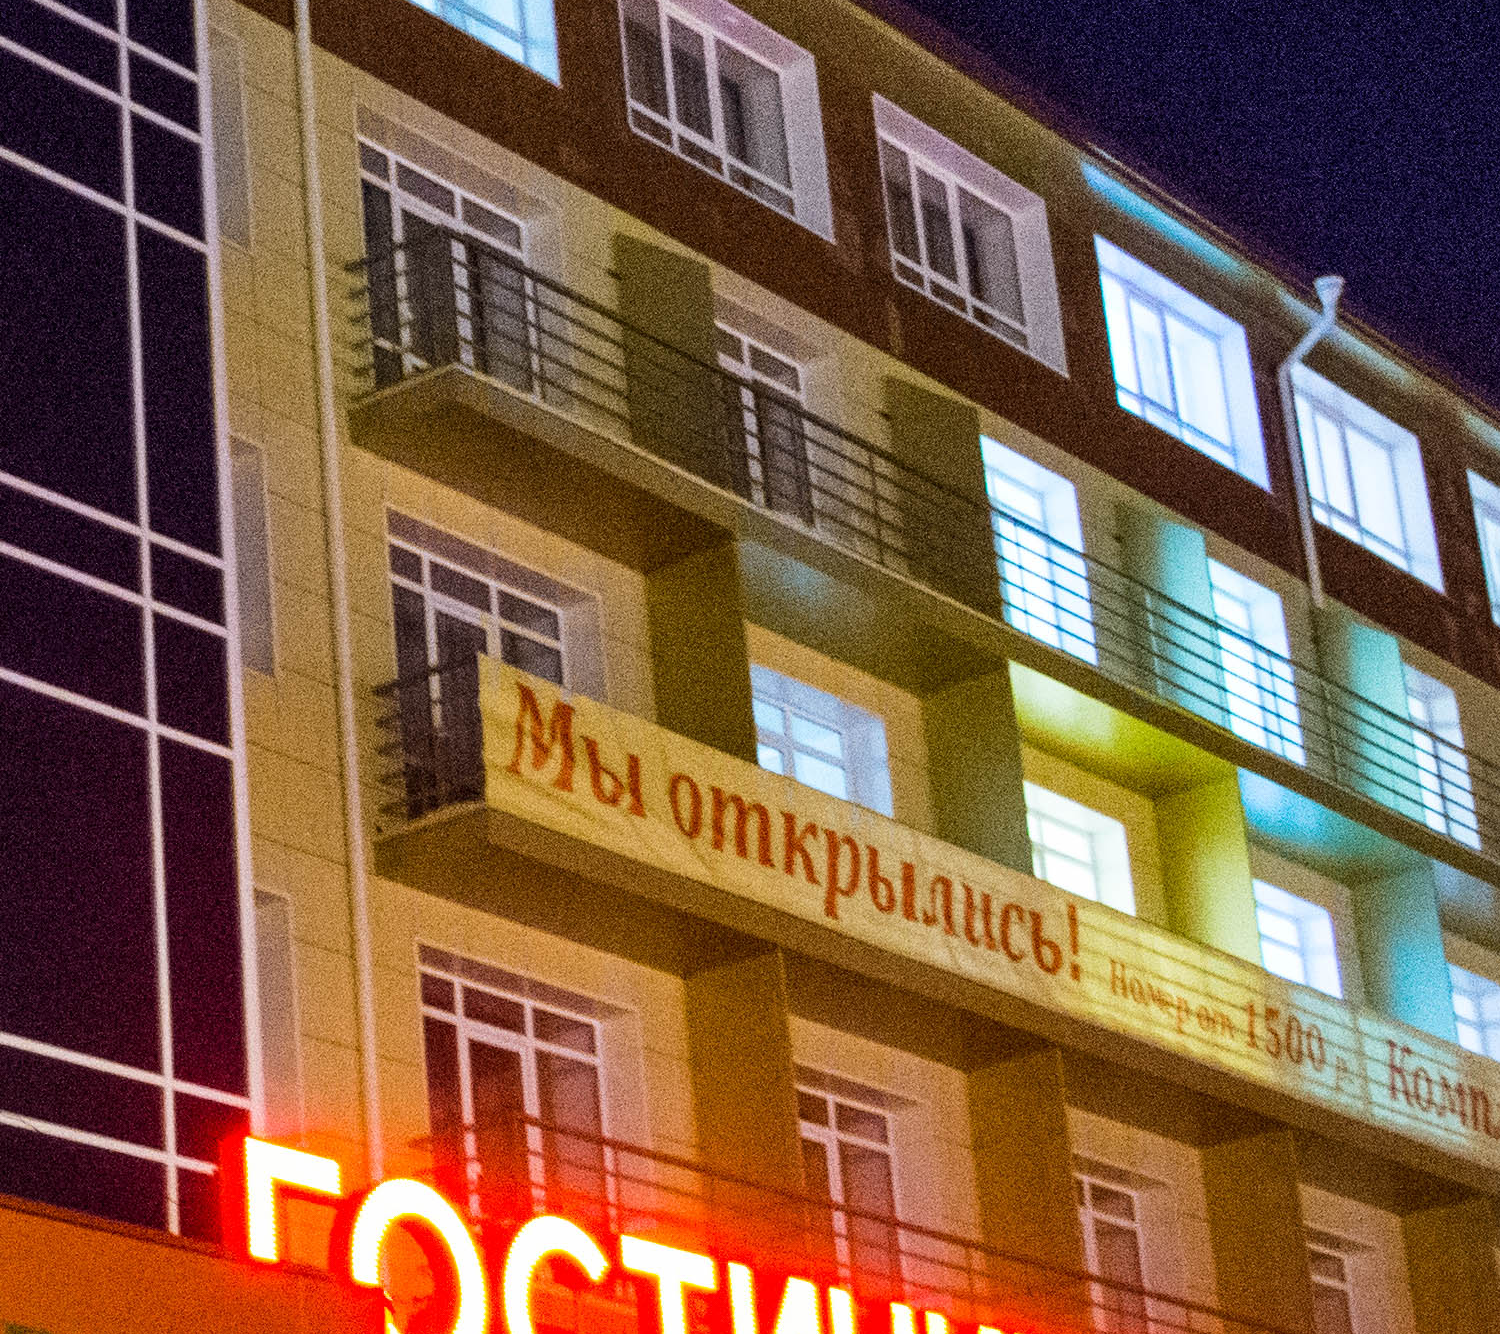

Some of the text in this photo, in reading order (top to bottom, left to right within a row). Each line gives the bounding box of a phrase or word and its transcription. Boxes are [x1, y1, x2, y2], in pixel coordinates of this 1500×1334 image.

[507, 680, 1082, 981] Мы открылись!
[1245, 1001, 1327, 1073] 1500
